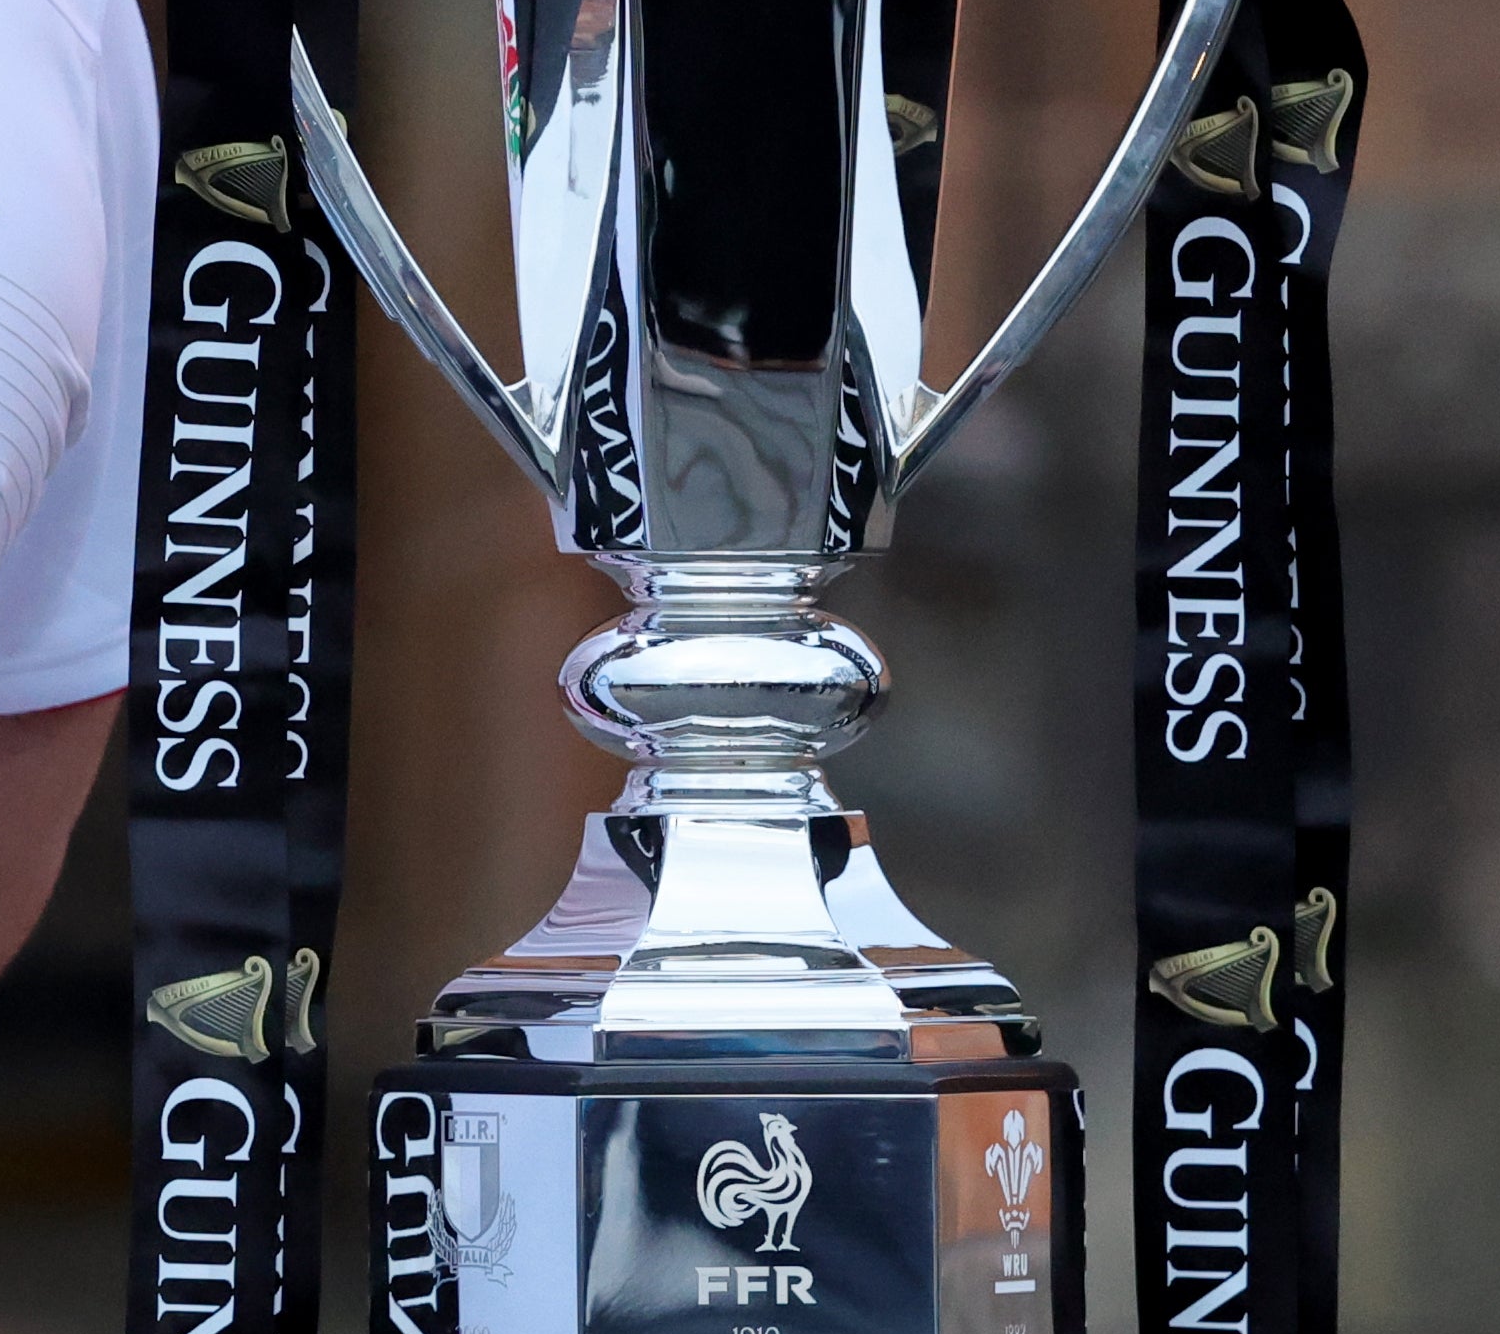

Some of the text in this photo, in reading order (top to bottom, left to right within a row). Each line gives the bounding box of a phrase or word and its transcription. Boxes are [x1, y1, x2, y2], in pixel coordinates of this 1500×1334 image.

[155, 240, 283, 793] GUINNESS
[1164, 216, 1257, 763] GUINNESS
[695, 1266, 817, 1305] FFR
[1002, 1253, 1028, 1277] WRU
